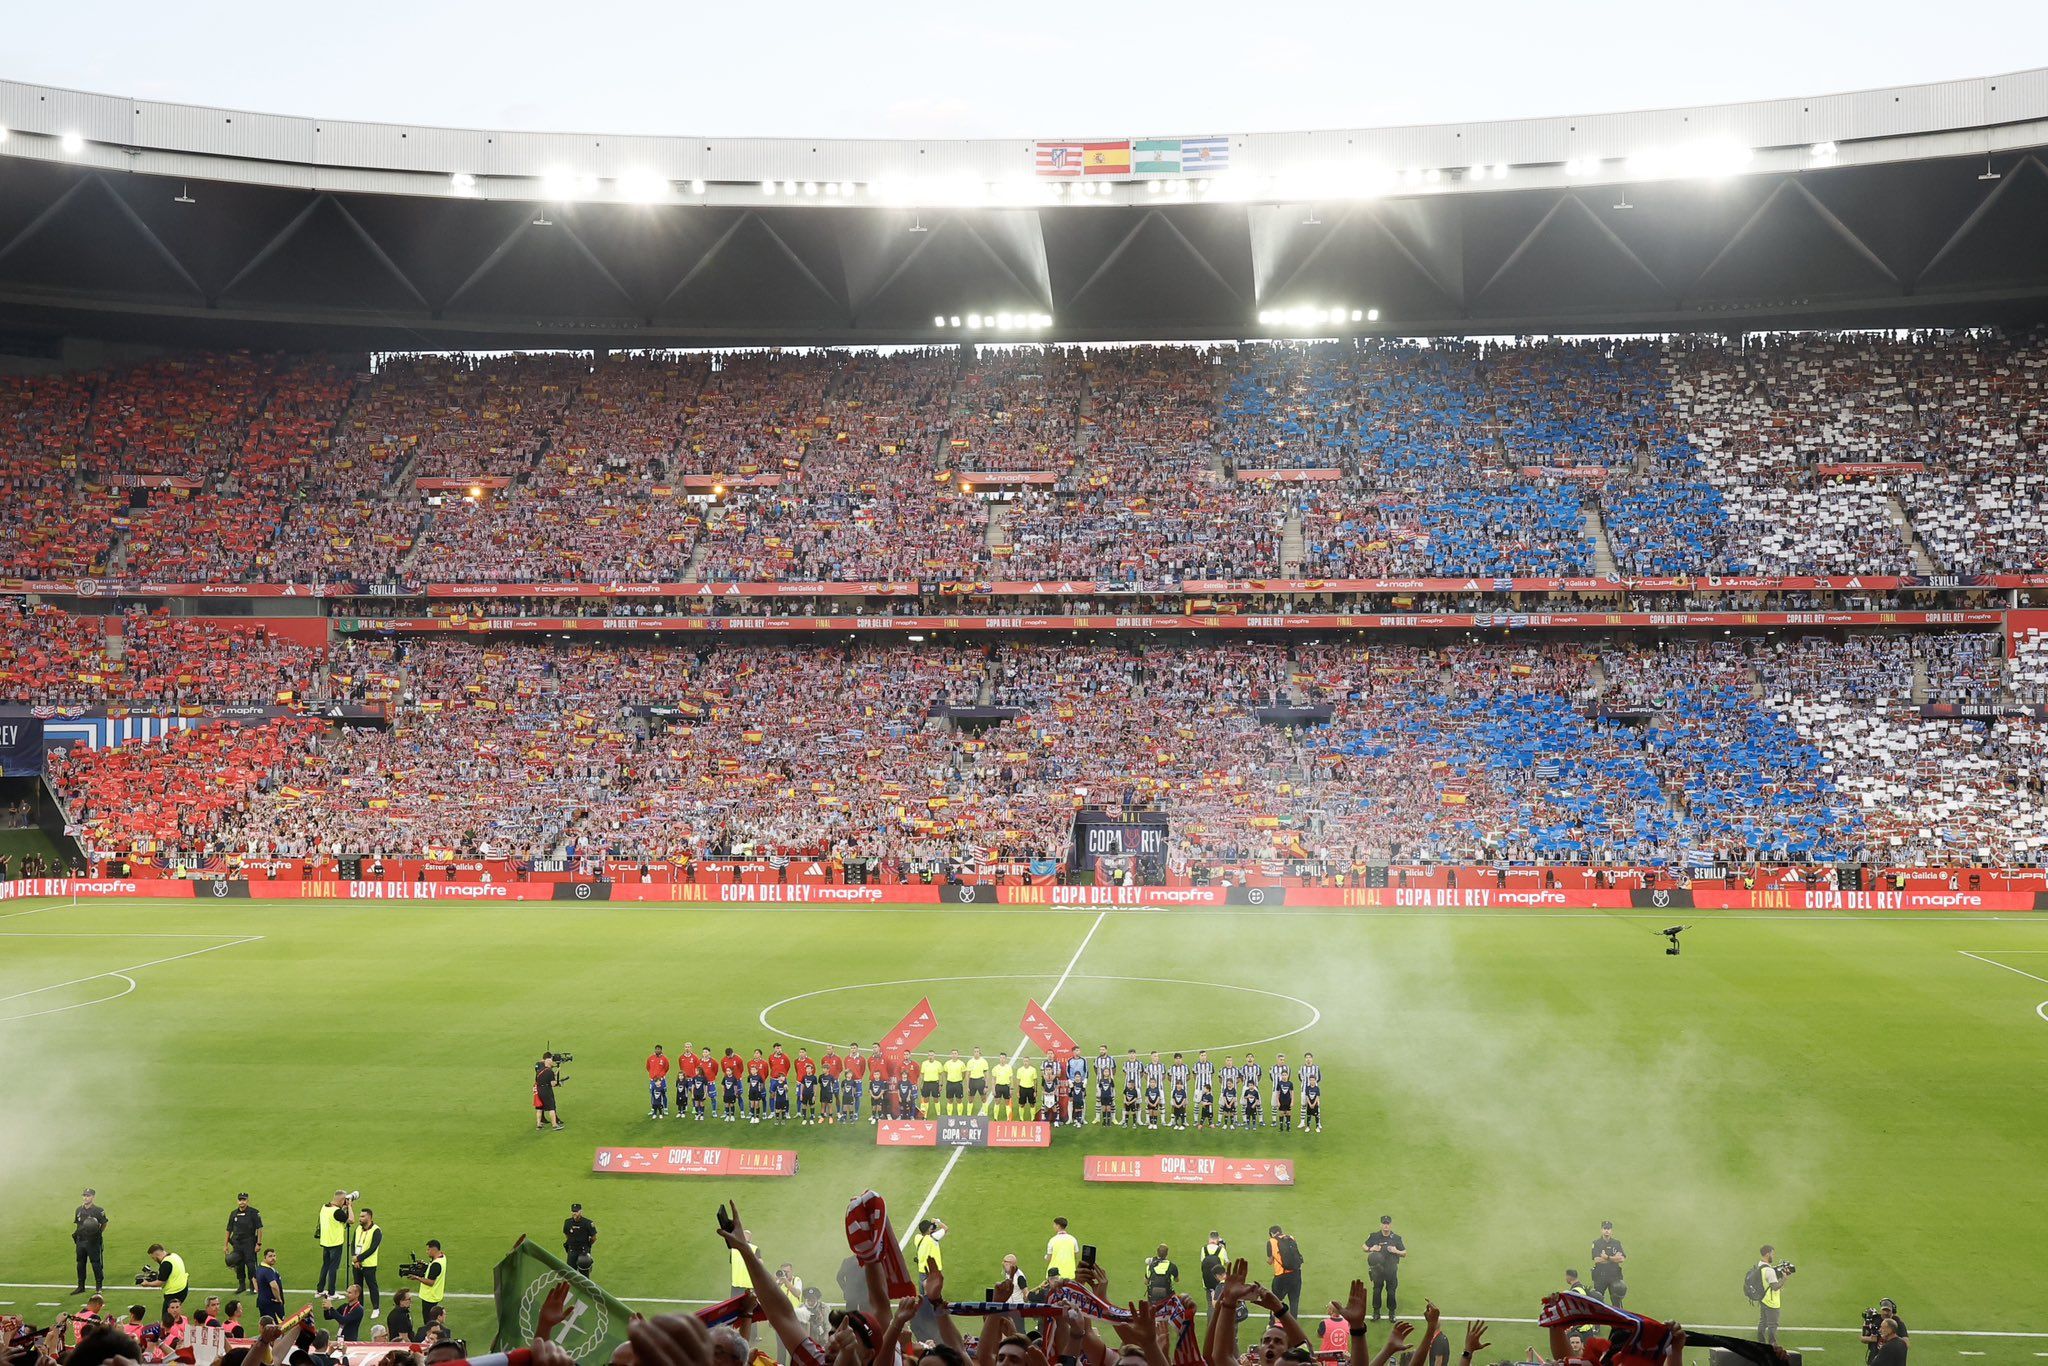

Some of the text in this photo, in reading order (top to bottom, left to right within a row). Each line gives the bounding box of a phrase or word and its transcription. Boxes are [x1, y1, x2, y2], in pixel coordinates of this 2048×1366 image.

[1929, 576, 1959, 586] SEVILLA
[215, 586, 247, 594] mapfre
[369, 585, 396, 595] SEVILLA
[628, 585, 660, 593] mapfre
[944, 619, 959, 627] FINAL
[986, 618, 1000, 627] COPA
[1001, 618, 1011, 627] DEL
[1012, 618, 1021, 627] REY
[1074, 618, 1089, 627] FINAL
[1116, 618, 1130, 626] COPA
[1131, 618, 1141, 626] DEL
[1142, 618, 1152, 626] REY
[1204, 617, 1220, 626] FINAL
[1247, 618, 1262, 626] COPA
[1262, 618, 1272, 626] DEL
[1273, 618, 1284, 626] REY
[1337, 617, 1352, 626] FINAL
[1380, 617, 1395, 625] COPA
[1396, 617, 1405, 625] DEL
[1407, 617, 1417, 625] REY
[1606, 616, 1621, 624] FINAL
[1650, 615, 1665, 624] COPA
[1666, 615, 1676, 624] DEL
[1677, 615, 1688, 624] REY
[1742, 615, 1758, 624] FINAL
[1787, 614, 1801, 623] COPA
[1802, 614, 1813, 623] DEL
[1814, 614, 1825, 623] REY
[1880, 613, 1896, 622] FINAL
[1925, 613, 1941, 622] COPA
[1942, 613, 1952, 622] DEL
[1954, 613, 1964, 622] REY
[358, 620, 368, 629] OPA
[563, 620, 578, 628] FINAL
[603, 619, 617, 628] COPA
[618, 619, 627, 628] DEL
[628, 619, 637, 628] REY
[688, 619, 703, 628] FINAL
[730, 619, 744, 628] COPA
[744, 619, 754, 628] DEL
[754, 619, 764, 628] REY
[816, 619, 831, 628] FINAL
[857, 619, 871, 628] COPA
[872, 619, 881, 628] DEL
[882, 619, 892, 628] REY
[226, 706, 264, 715] mapfre
[1961, 705, 1978, 714] COPA
[1980, 705, 1991, 714] DEL
[1993, 705, 2004, 714] REY
[0, 726, 18, 745] EY
[1089, 829, 1162, 852] COPA REY
[169, 859, 292, 870] SELLA mafre
[534, 861, 564, 872] SEVILLA
[722, 864, 765, 873] mpfre
[910, 863, 939, 874] SEVLA
[1694, 868, 1727, 879] SEVILLA
[18, 880, 39, 896] DEL
[45, 879, 68, 896] REY
[76, 880, 136, 894] mapfre
[302, 881, 506, 899] FINAL COPA DEL REY mapfre
[672, 884, 882, 901] FINAL COPA DEL REY mapfre
[1008, 886, 1214, 904] FINAL COPA DEL REY mapfre
[1344, 889, 1565, 906] FINAL COPA DEL REY mapfre
[1751, 891, 1982, 909] FINAL COPA DEL REY mapfre
[943, 1129, 982, 1140] COPA REY
[996, 1126, 1034, 1137] FINAL
[669, 1149, 721, 1165] COPA REY
[740, 1154, 775, 1166] FINAL
[1097, 1161, 1134, 1172] FINAL
[1162, 1158, 1215, 1173] COPA REY
